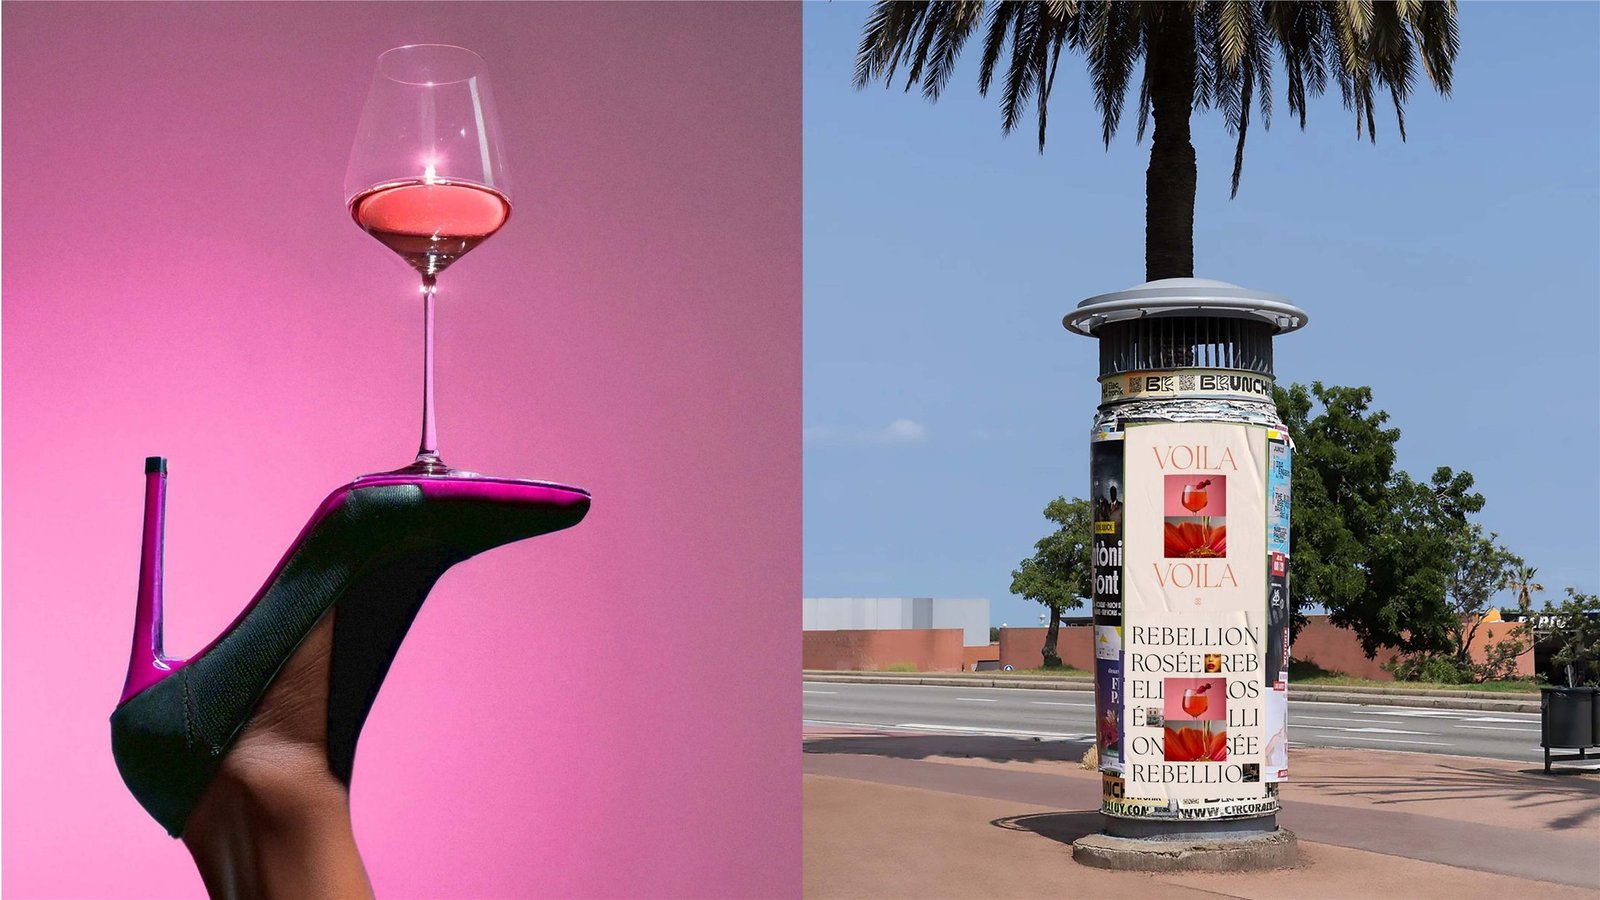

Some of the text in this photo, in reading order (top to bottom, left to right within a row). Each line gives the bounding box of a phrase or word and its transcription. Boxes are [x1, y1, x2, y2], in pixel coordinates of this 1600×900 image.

[1153, 445, 1238, 470] VOILA
[1153, 562, 1238, 588] VOILA
[1132, 626, 1259, 646] REBELLION
[1132, 652, 1201, 673] ROSÉE
[1226, 680, 1259, 699] OS
[1132, 764, 1242, 784] REBELLIO
